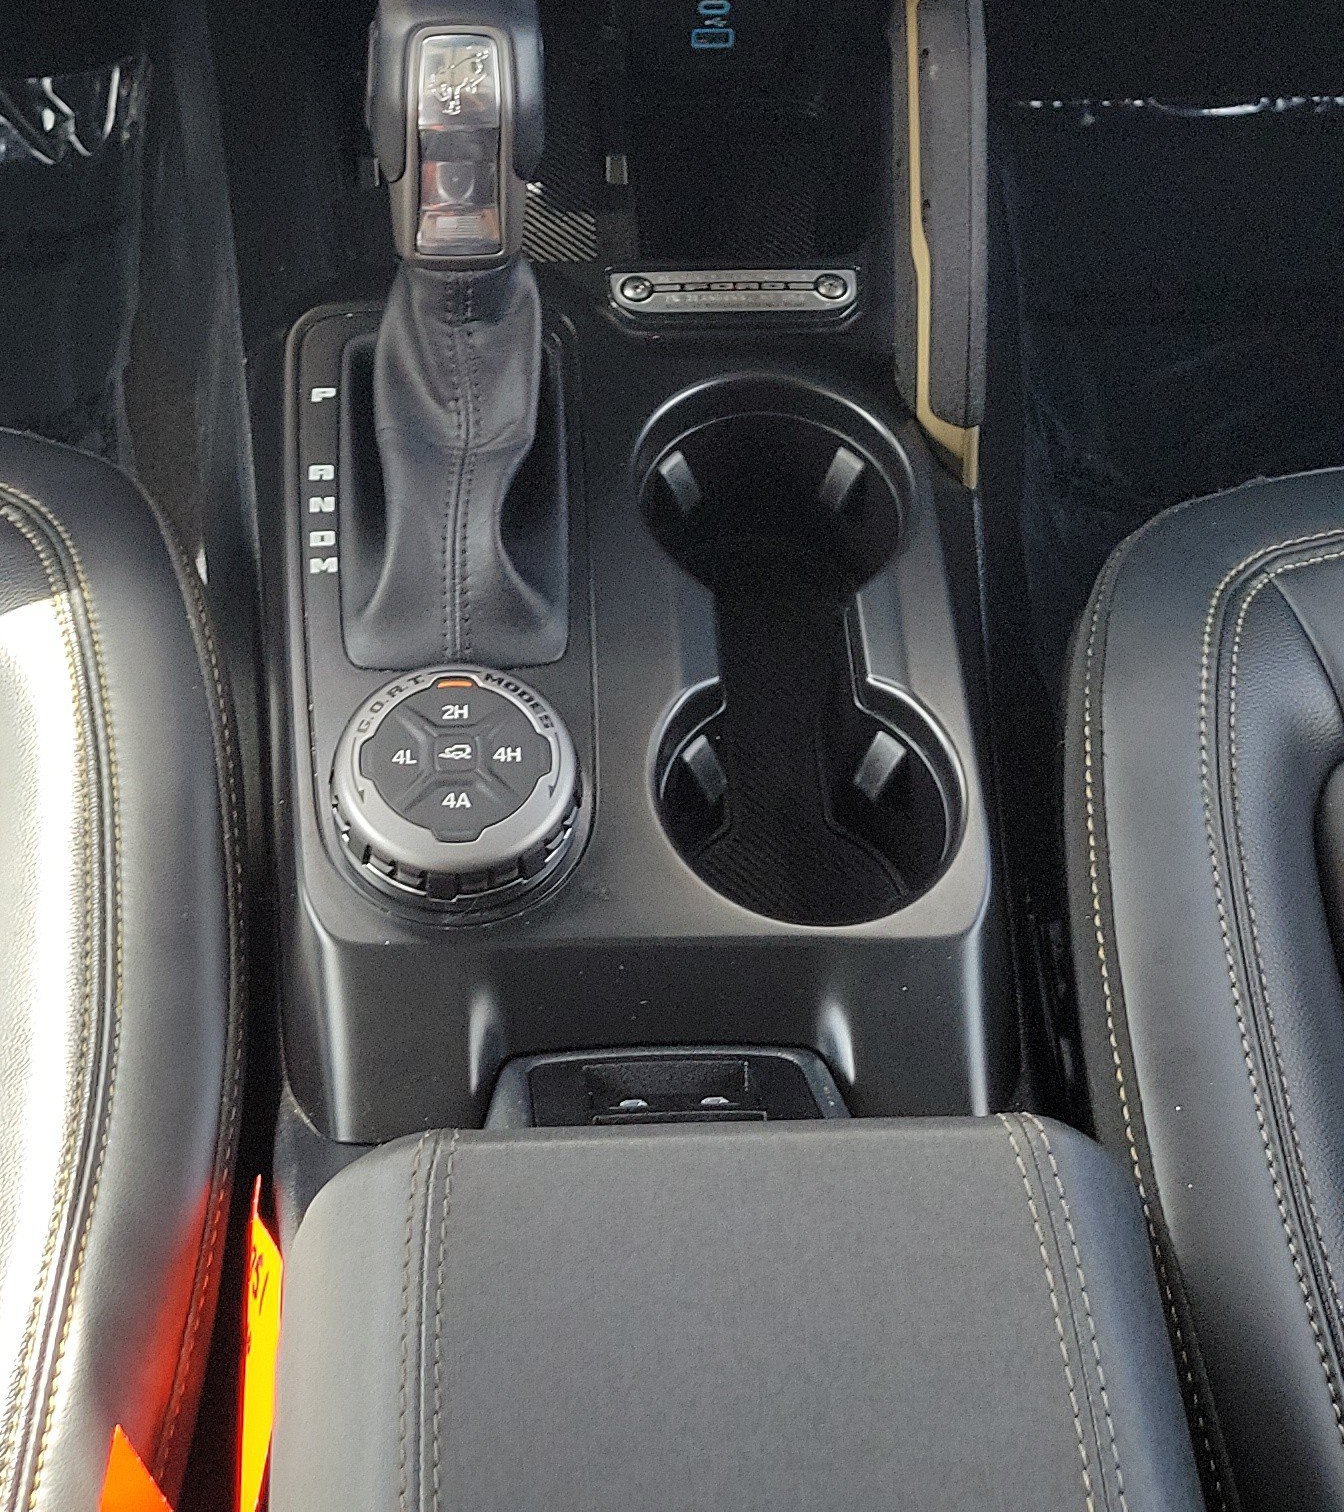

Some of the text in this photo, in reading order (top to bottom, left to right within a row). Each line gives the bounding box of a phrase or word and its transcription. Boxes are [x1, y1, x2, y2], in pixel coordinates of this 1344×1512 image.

[311, 387, 337, 402] P
[308, 496, 336, 513] N
[309, 530, 336, 547] D
[309, 556, 339, 574] M
[484, 672, 556, 730] MODES
[441, 704, 469, 720] 2H
[391, 750, 417, 765] 4L
[492, 747, 522, 763] 4H
[441, 792, 472, 809] 4A
